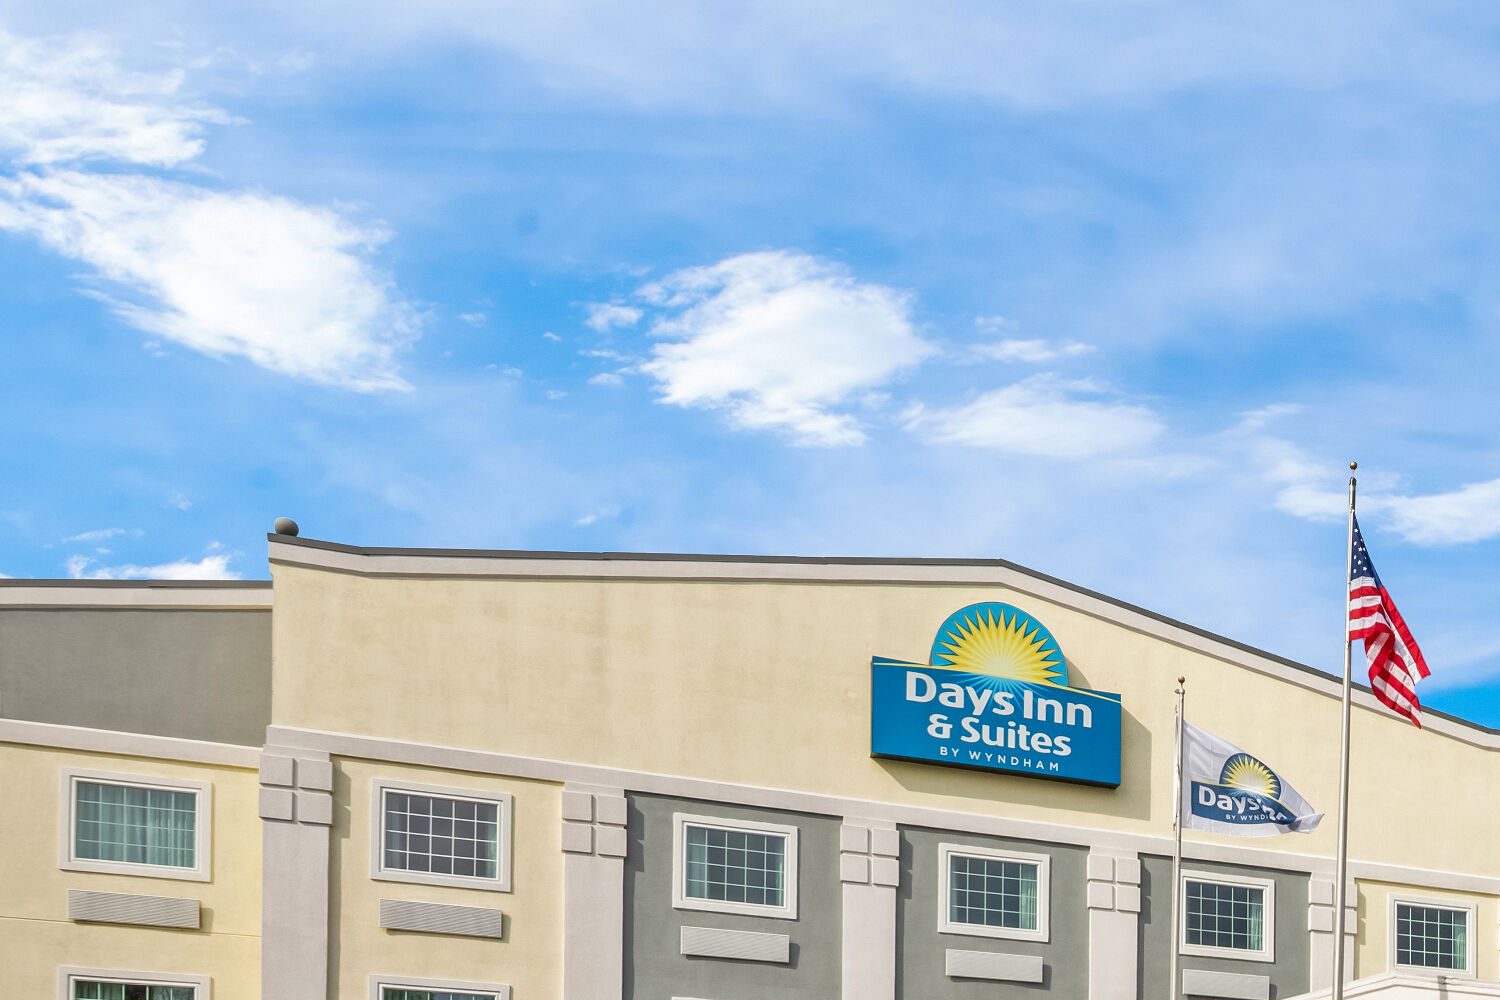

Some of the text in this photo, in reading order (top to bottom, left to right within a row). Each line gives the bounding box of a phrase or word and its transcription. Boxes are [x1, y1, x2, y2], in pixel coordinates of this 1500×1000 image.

[906, 671, 1092, 728] Days Inn
[927, 713, 1072, 756] & Suites
[940, 746, 1059, 772] BY WYNDHAM
[1198, 784, 1260, 814] Days
